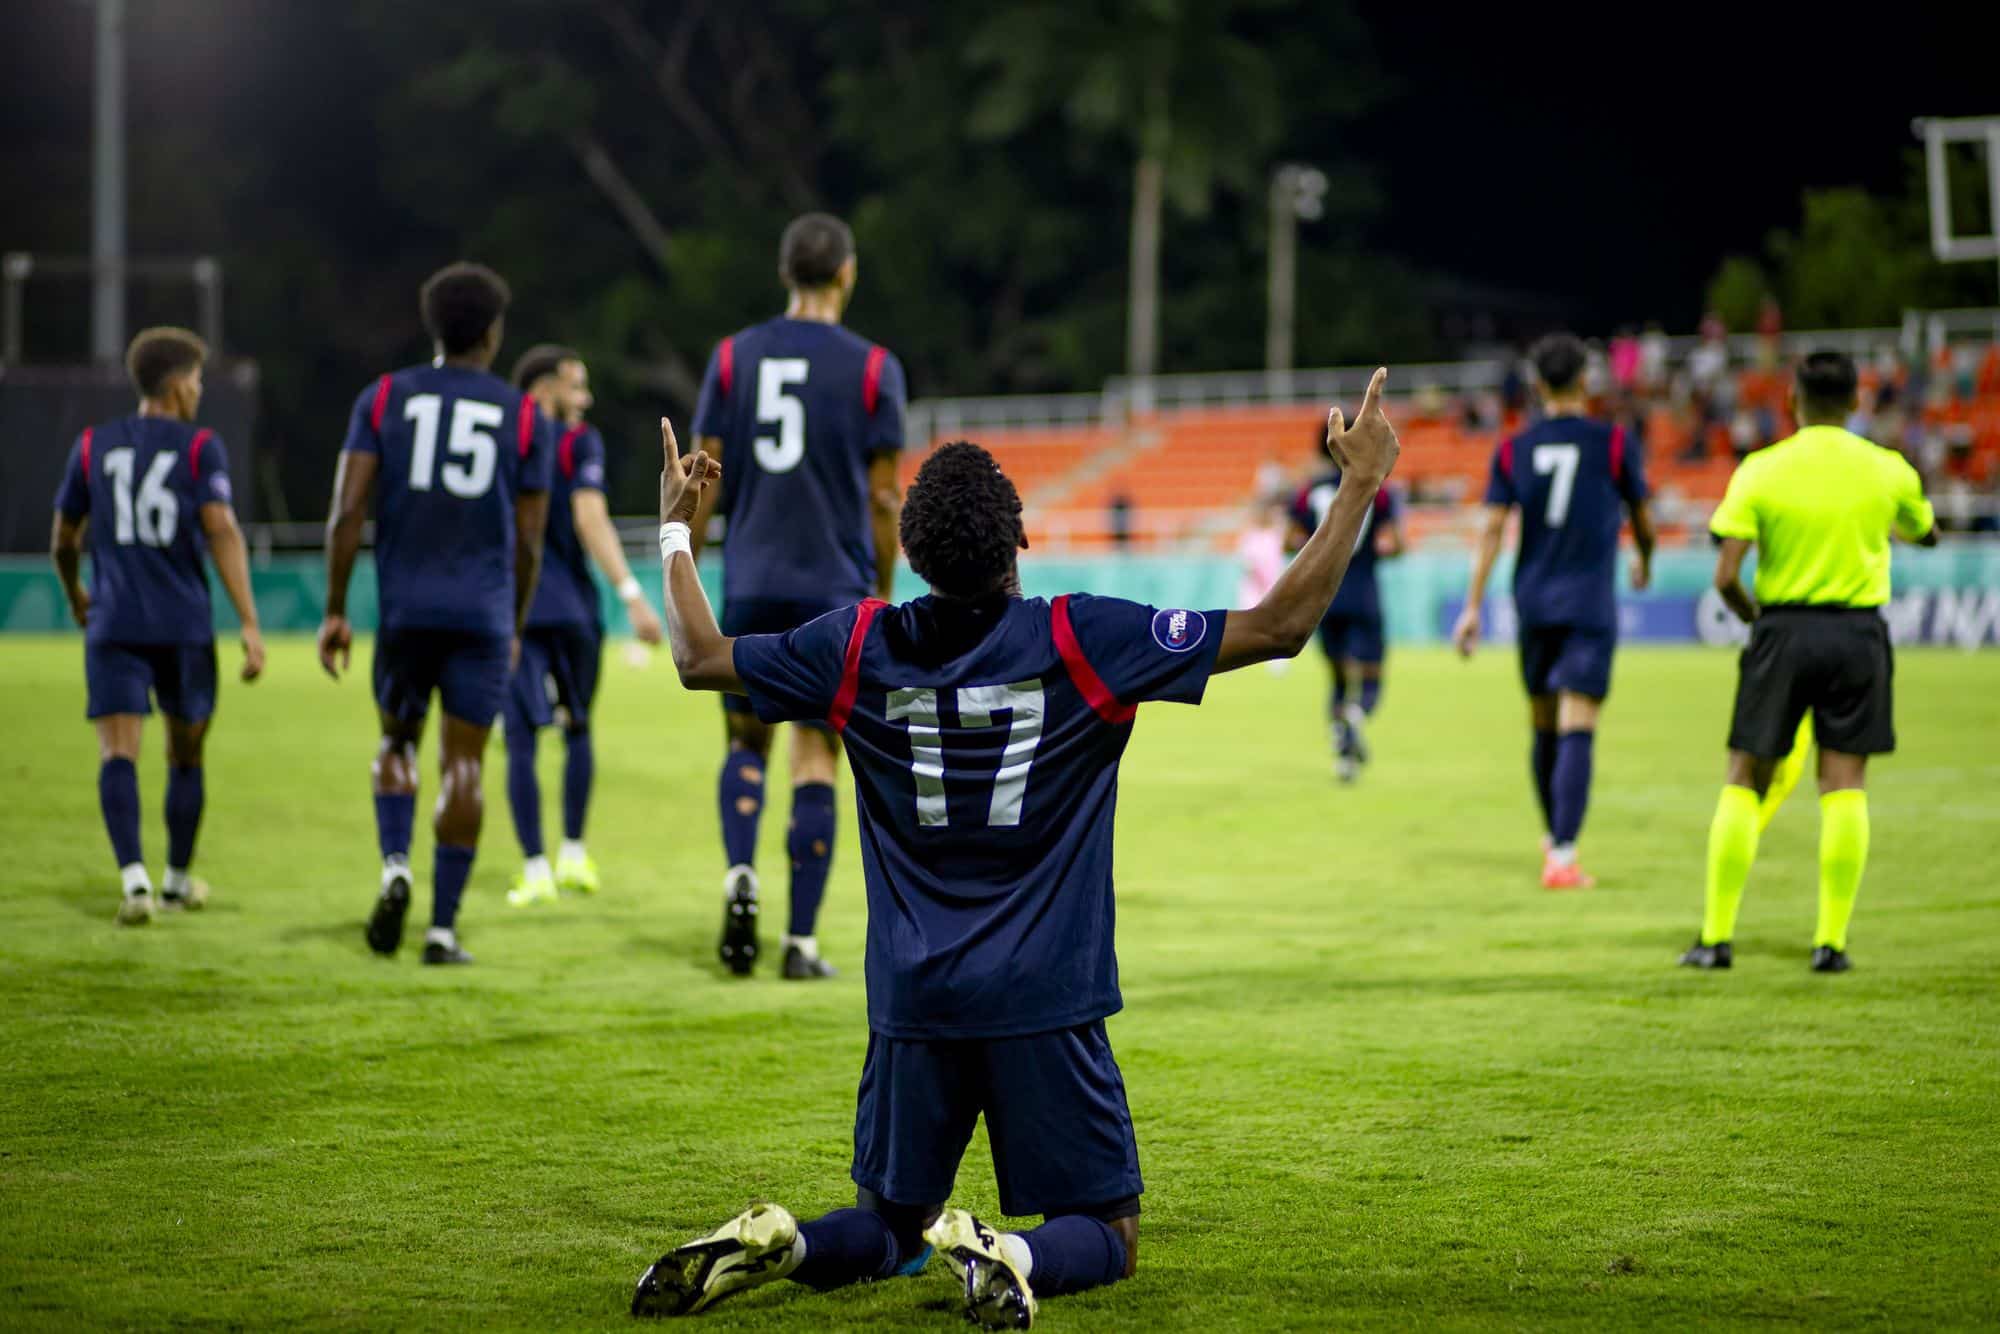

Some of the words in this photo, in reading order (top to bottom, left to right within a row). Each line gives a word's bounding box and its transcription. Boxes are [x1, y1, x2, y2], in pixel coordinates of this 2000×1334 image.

[404, 393, 504, 497] 15
[754, 357, 810, 474] 5
[103, 447, 178, 546] 16
[1532, 443, 1580, 526] 7
[885, 678, 1046, 827] 17
